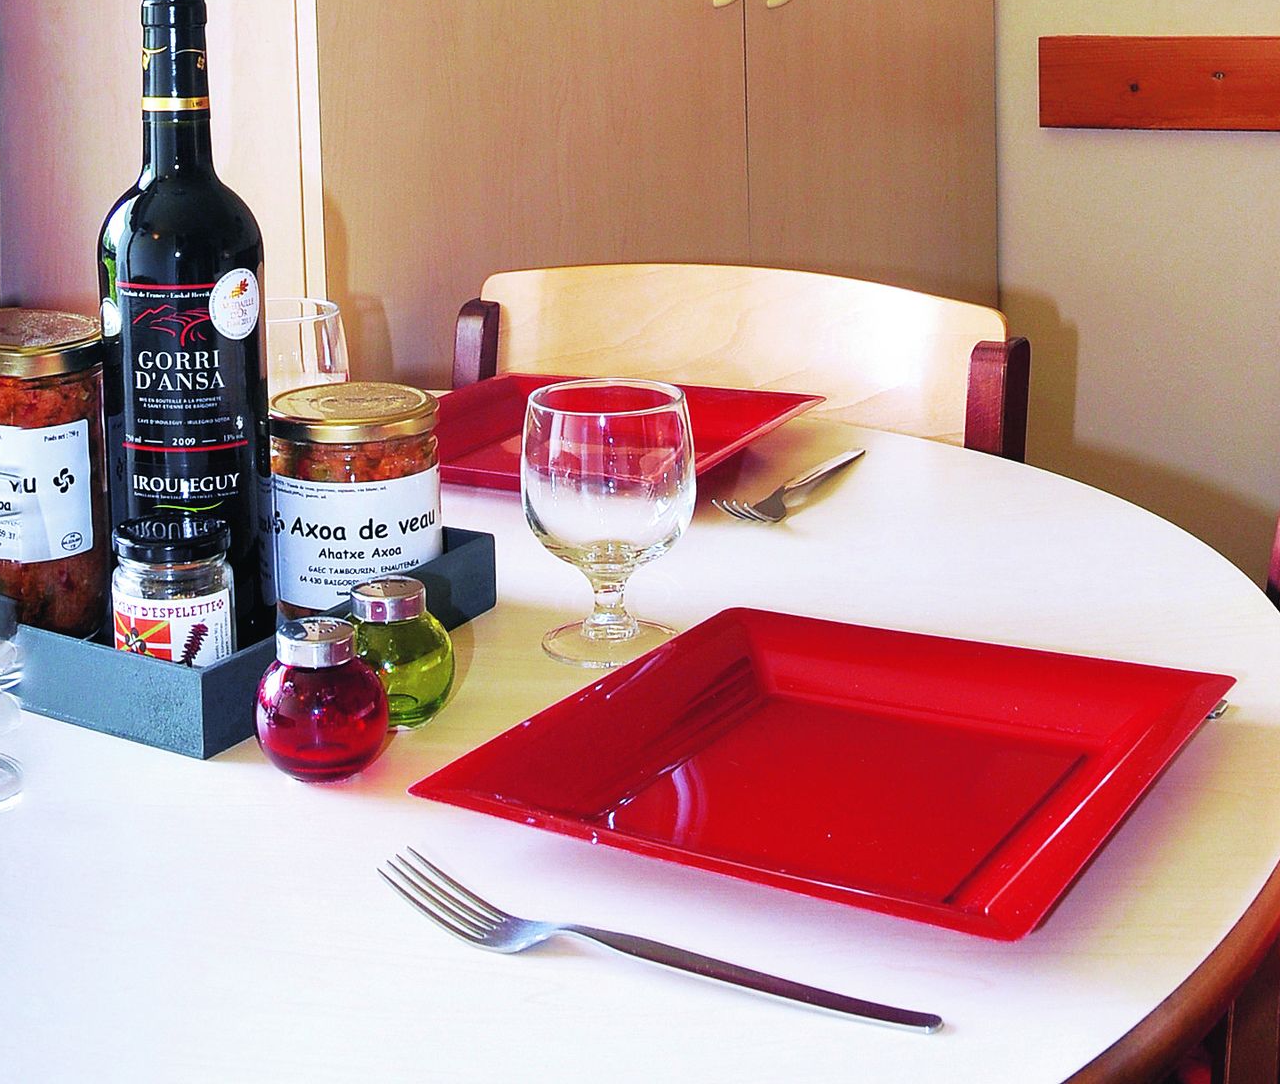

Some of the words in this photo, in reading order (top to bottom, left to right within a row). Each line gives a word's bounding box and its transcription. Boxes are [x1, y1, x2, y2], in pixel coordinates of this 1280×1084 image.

[137, 349, 221, 371] GORRI
[134, 370, 226, 392] D'ANSA
[172, 437, 196, 446] 2009
[132, 472, 240, 493] IROULEGUY
[290, 516, 347, 541] Axoa
[358, 518, 389, 540] de
[398, 509, 436, 535] veau
[318, 547, 366, 560] Ahatxe
[371, 546, 402, 559] Axoa
[308, 565, 326, 574] GAEC
[141, 600, 217, 619] D'ESPELETTE
